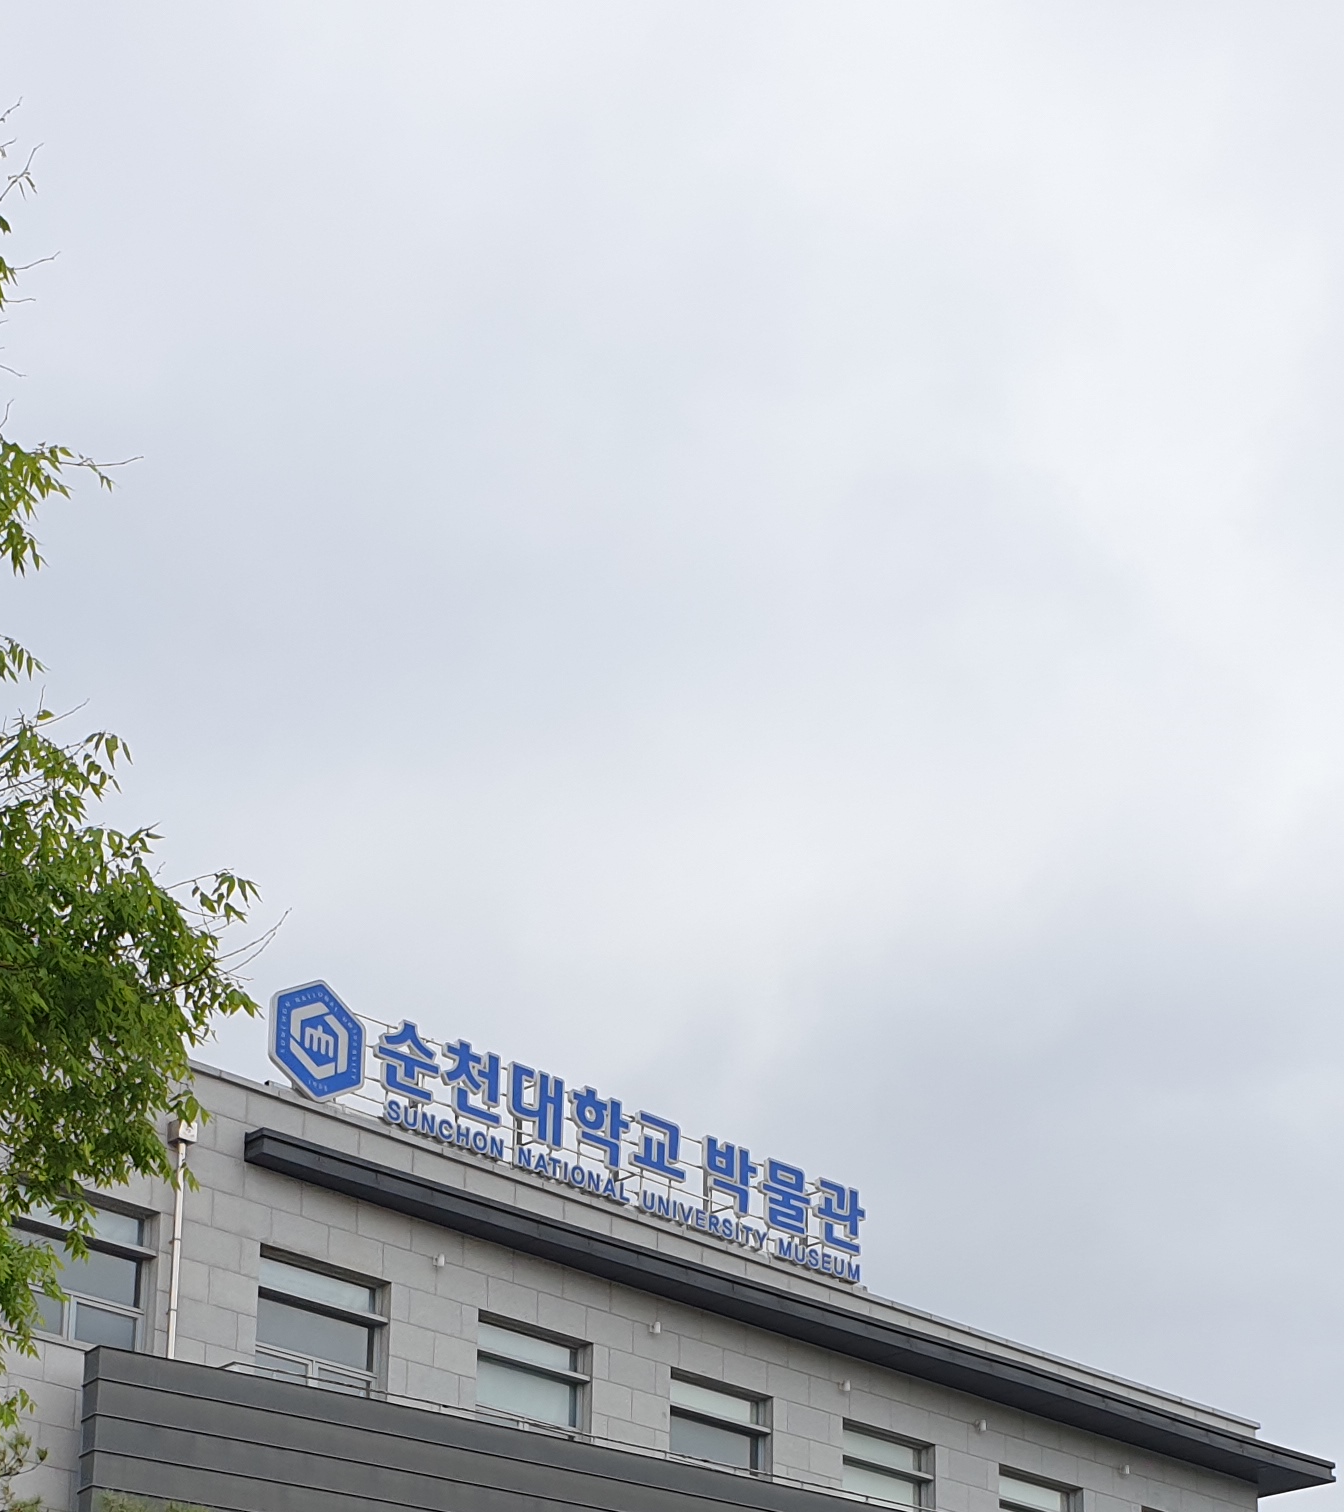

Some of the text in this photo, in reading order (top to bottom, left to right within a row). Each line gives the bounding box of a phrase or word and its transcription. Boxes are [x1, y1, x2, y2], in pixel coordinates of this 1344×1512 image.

[374, 1019, 866, 1256] 순천대학교 박물관
[384, 1099, 861, 1283] SUNCHON NATIONAL UNIVERSITY MUSEUM
